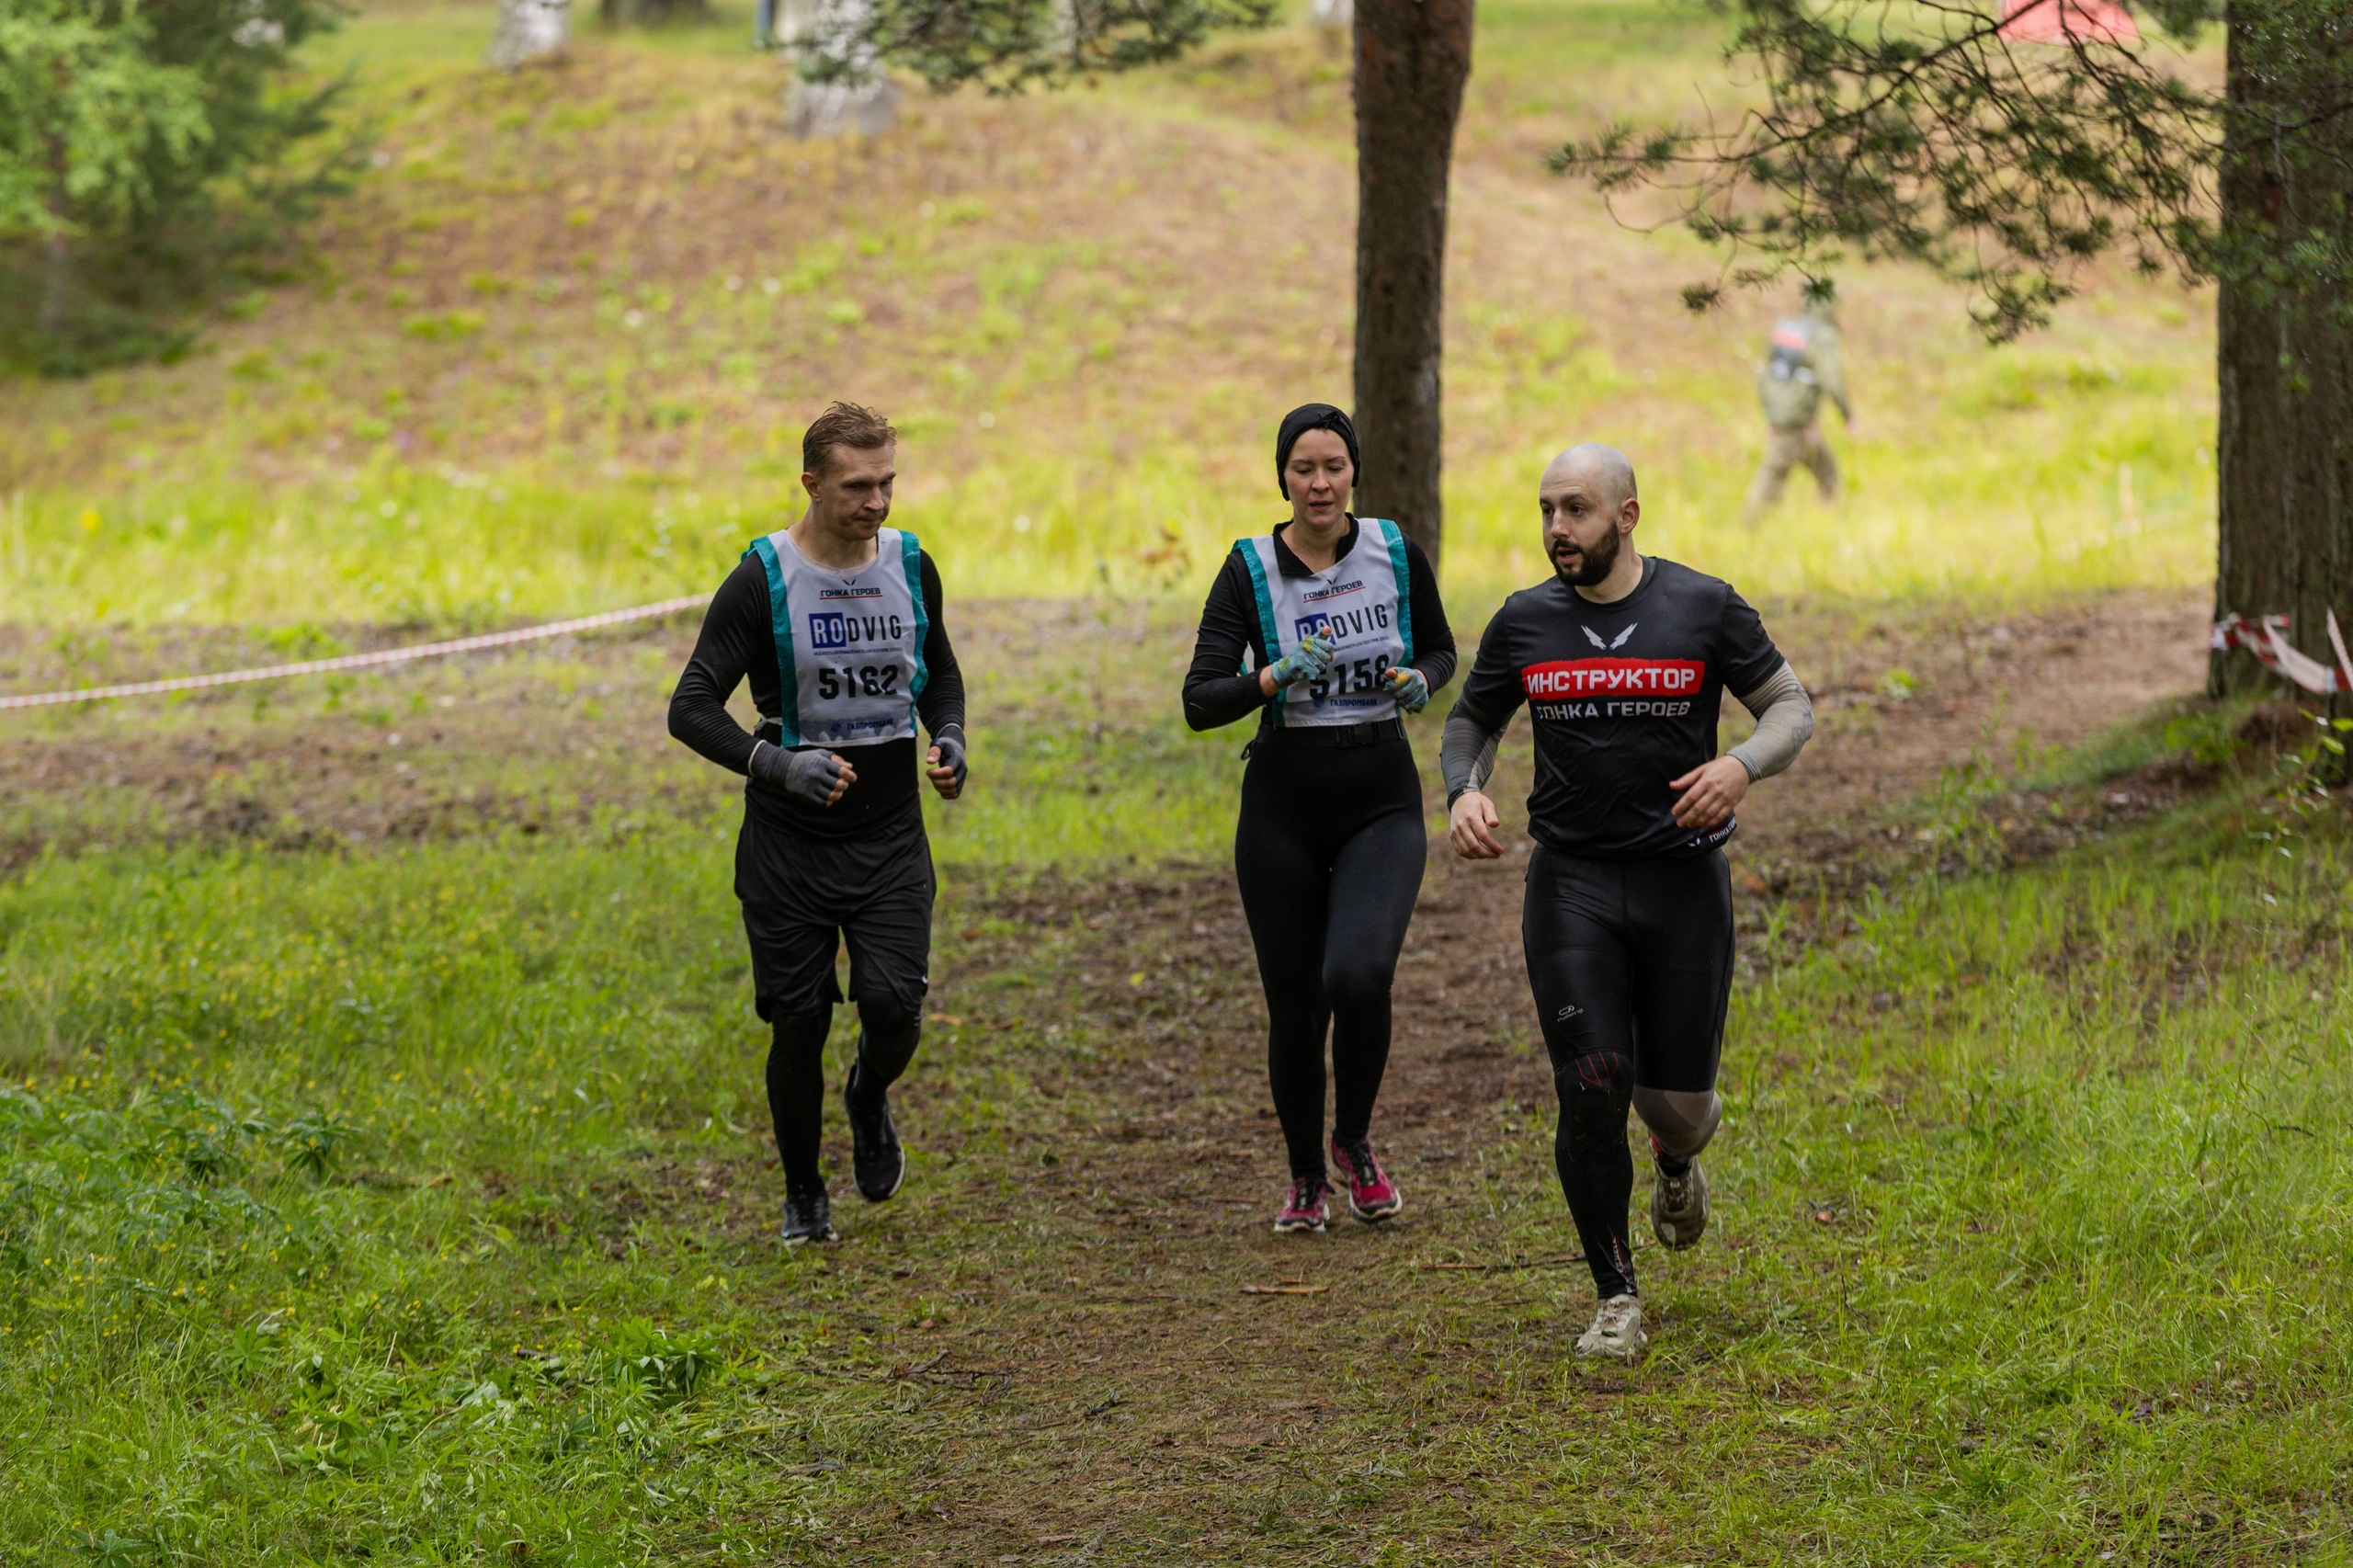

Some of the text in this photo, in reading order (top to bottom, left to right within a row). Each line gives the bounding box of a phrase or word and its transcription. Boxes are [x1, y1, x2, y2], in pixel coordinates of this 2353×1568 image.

[821, 587, 881, 597] ГОНКА ГЕРОЕВ
[1302, 580, 1363, 600] ГОНКА ГЕРОЕВ
[813, 615, 903, 644] RODVIG
[818, 665, 899, 699] 5162
[1310, 653, 1390, 699] 5158
[1527, 668, 1696, 694] ИНСТРУКТОР
[1330, 699, 1378, 707] ГАЗПРОМБАНК
[1607, 701, 1690, 717] ГЕРОЕВ
